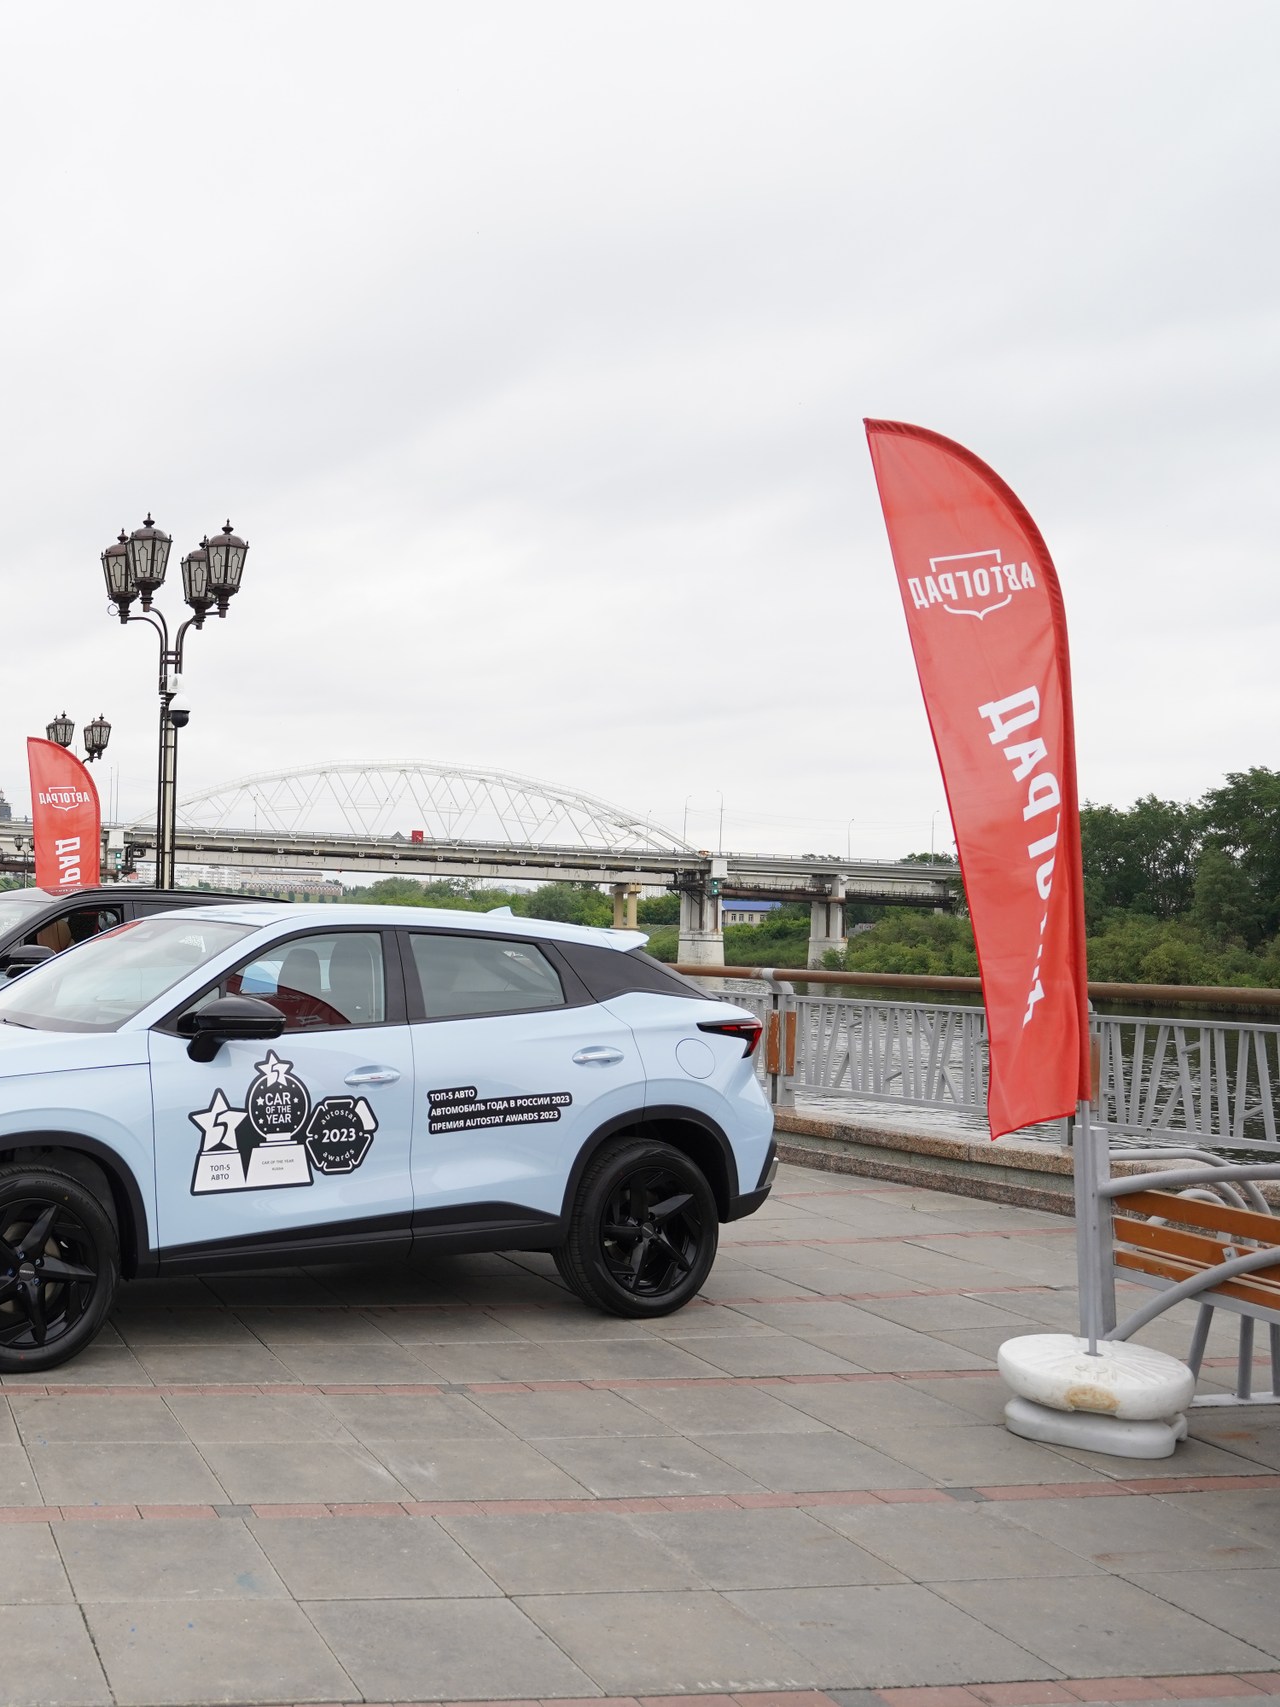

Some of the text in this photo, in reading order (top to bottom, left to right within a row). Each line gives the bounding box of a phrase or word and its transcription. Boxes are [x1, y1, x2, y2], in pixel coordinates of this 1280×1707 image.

[265, 1092, 291, 1106] CAR
[430, 1089, 475, 1101] ТОП-5 АВТО
[266, 1105, 291, 1114] OF THE
[431, 1095, 570, 1116] АВТОМОБИЛЬ ГОДА В РОССИИ 2023
[266, 1114, 292, 1124] YEAR
[321, 1110, 357, 1125] autostat
[431, 1110, 559, 1131] ПРЕМИЯ AUTOSTAT AWARDS 2023
[322, 1128, 356, 1143] 2023
[322, 1149, 355, 1162] awards
[210, 1164, 231, 1172] ТОП-5
[211, 1173, 230, 1181] АВТО
